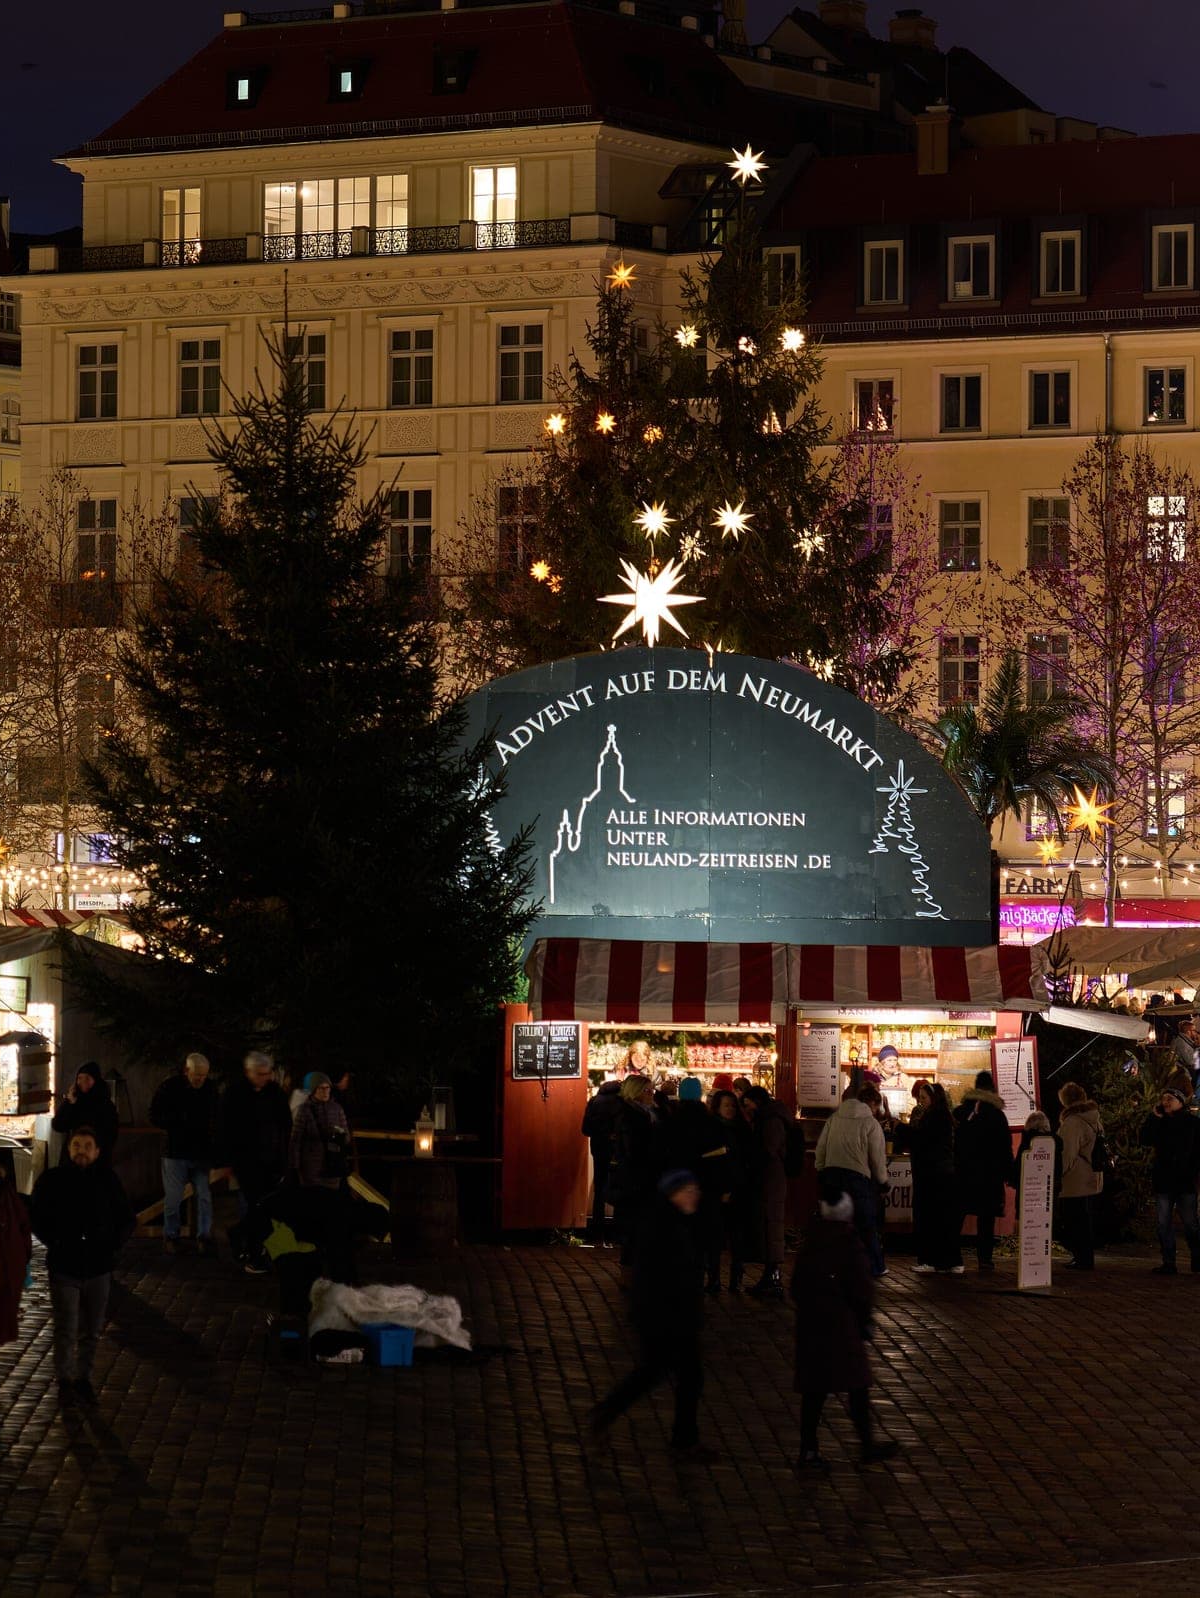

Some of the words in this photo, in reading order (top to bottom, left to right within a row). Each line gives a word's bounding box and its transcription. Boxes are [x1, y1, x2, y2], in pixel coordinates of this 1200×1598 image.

[494, 685, 595, 766] ADVENT
[604, 670, 656, 700] AUF
[667, 669, 727, 693] DEM
[738, 672, 885, 773] NEUMARKT
[606, 808, 647, 825] ALLE
[654, 809, 806, 827] INFORMATIONEN
[607, 829, 669, 847] UNTER
[607, 852, 798, 869] NEULAND-ZEITREISEN
